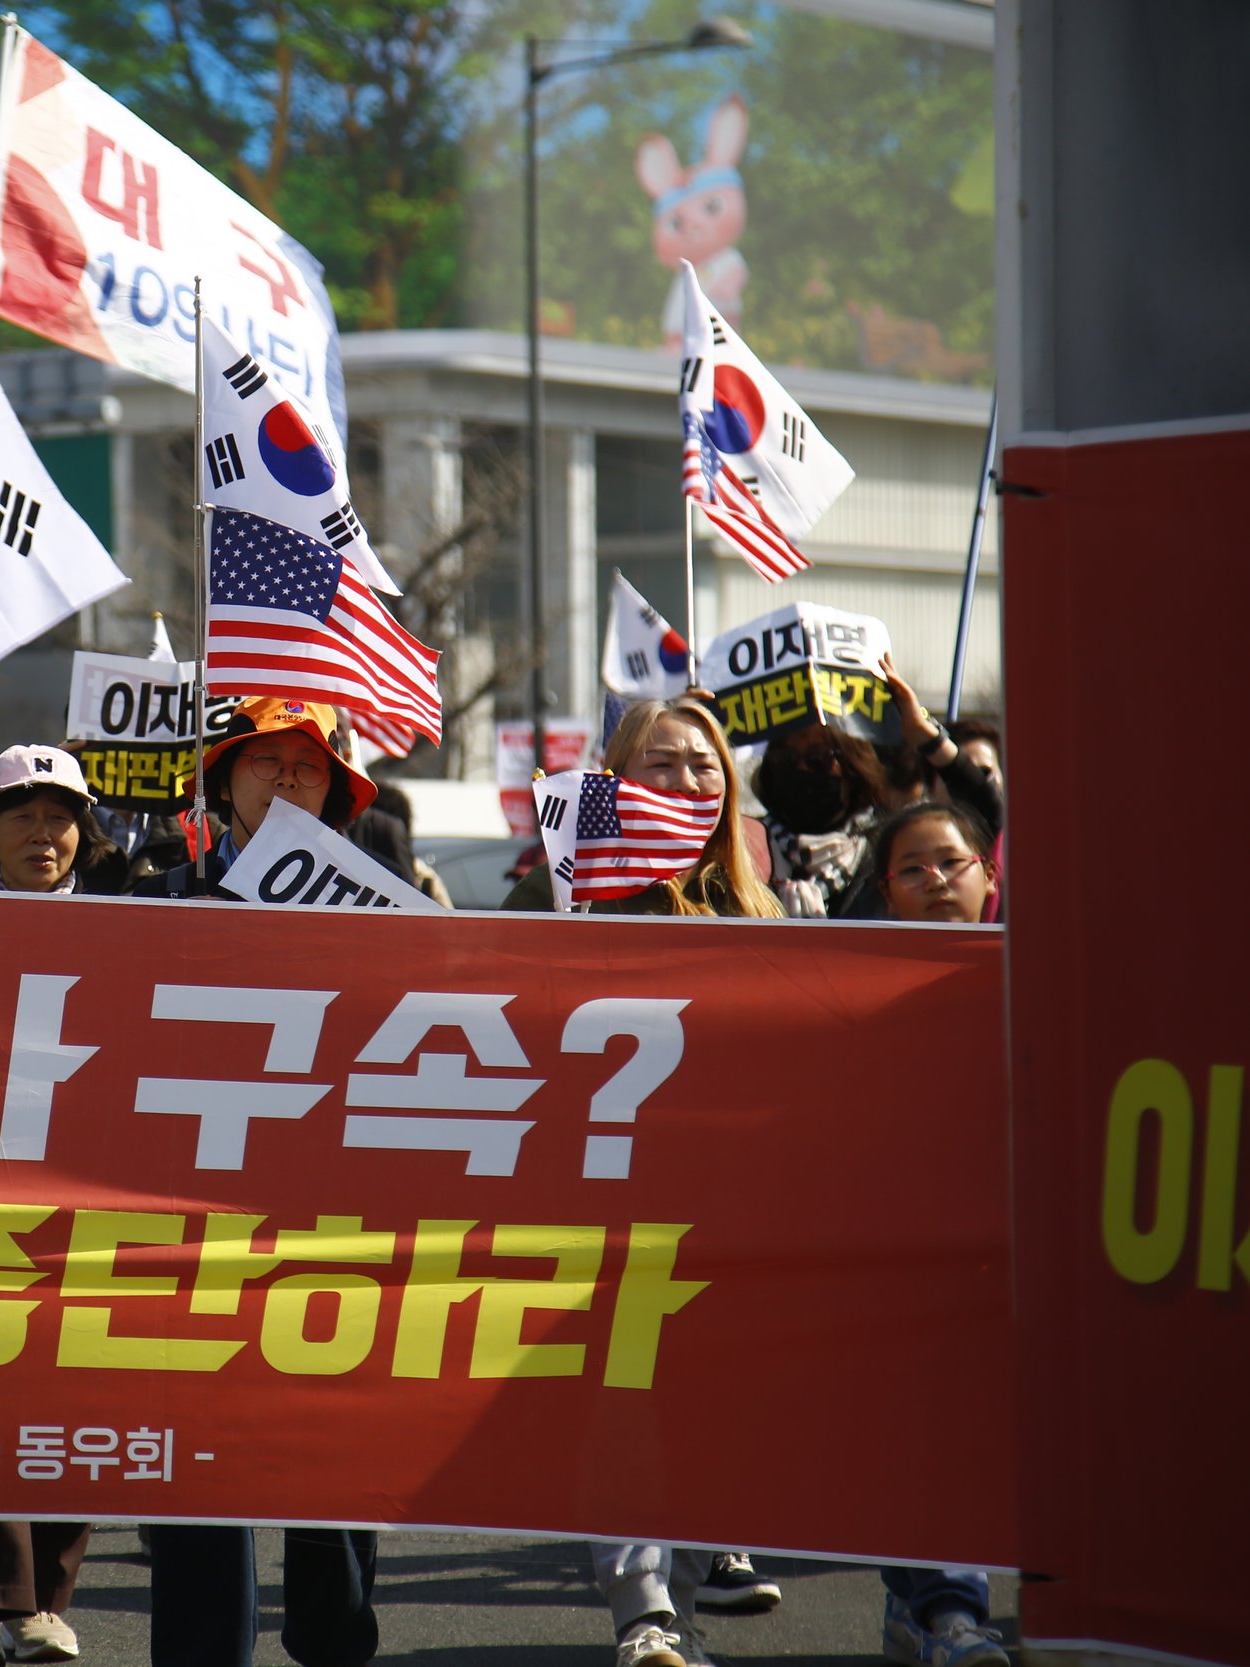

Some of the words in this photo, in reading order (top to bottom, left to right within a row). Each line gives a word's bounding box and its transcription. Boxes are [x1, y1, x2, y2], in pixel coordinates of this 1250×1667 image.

[729, 622, 867, 676] 이재명
[718, 664, 892, 737] 재판받자
[33, 757, 54, 774] N
[134, 984, 693, 1179] 구속?
[1103, 1058, 1250, 1292] 이
[16, 1425, 174, 1482] 동우회
